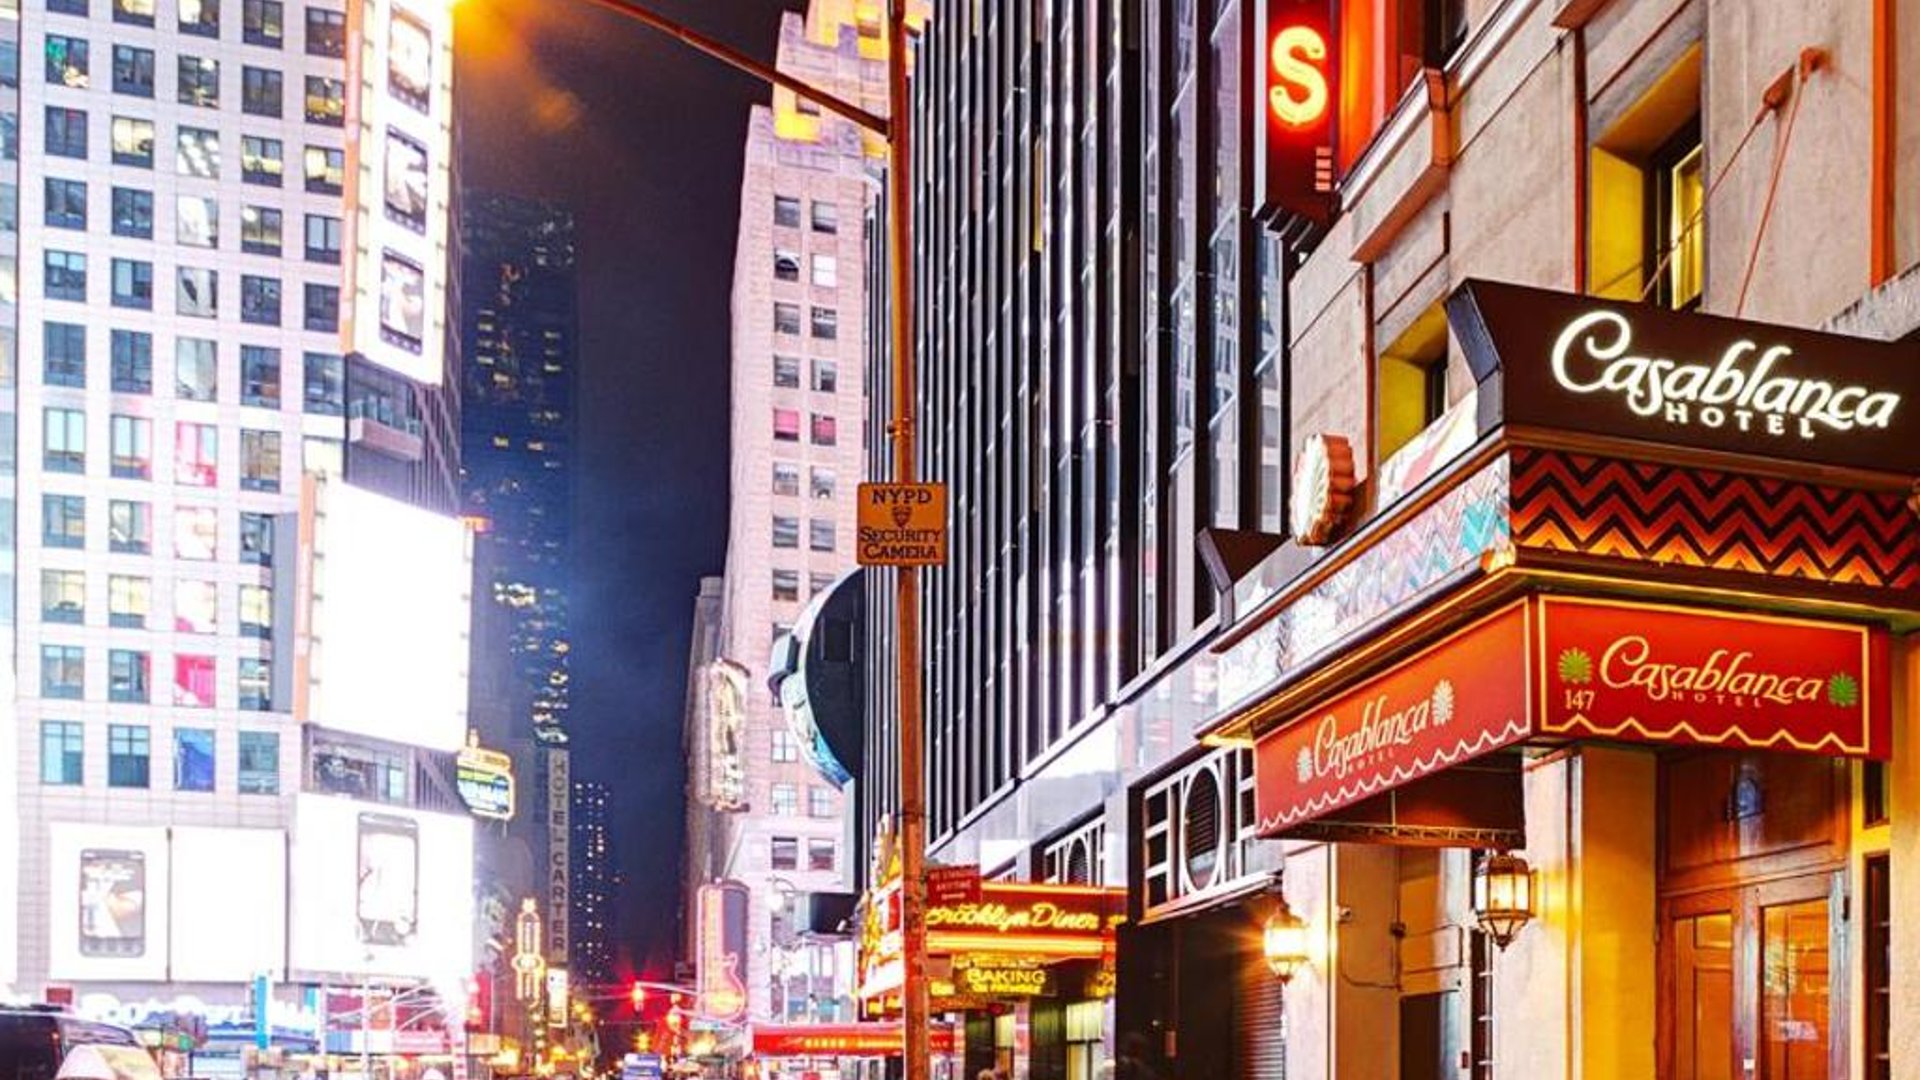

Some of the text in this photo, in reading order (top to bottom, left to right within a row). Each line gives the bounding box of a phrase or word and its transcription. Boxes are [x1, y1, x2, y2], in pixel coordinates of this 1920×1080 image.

[1551, 309, 1901, 431] Casablanca
[1664, 401, 1816, 439] HOTEL
[872, 488, 933, 505] NYPD
[859, 526, 942, 543] SECURITY
[863, 543, 937, 560] CAMERA
[1599, 634, 1824, 705] Casablanca
[1564, 689, 1596, 711] 147
[1671, 690, 1763, 709] HOTEL
[1313, 694, 1430, 780] Casablanca
[552, 760, 566, 951] HOTEL CARTER
[1032, 902, 1099, 930] Diner
[967, 968, 1047, 985] BAKING
